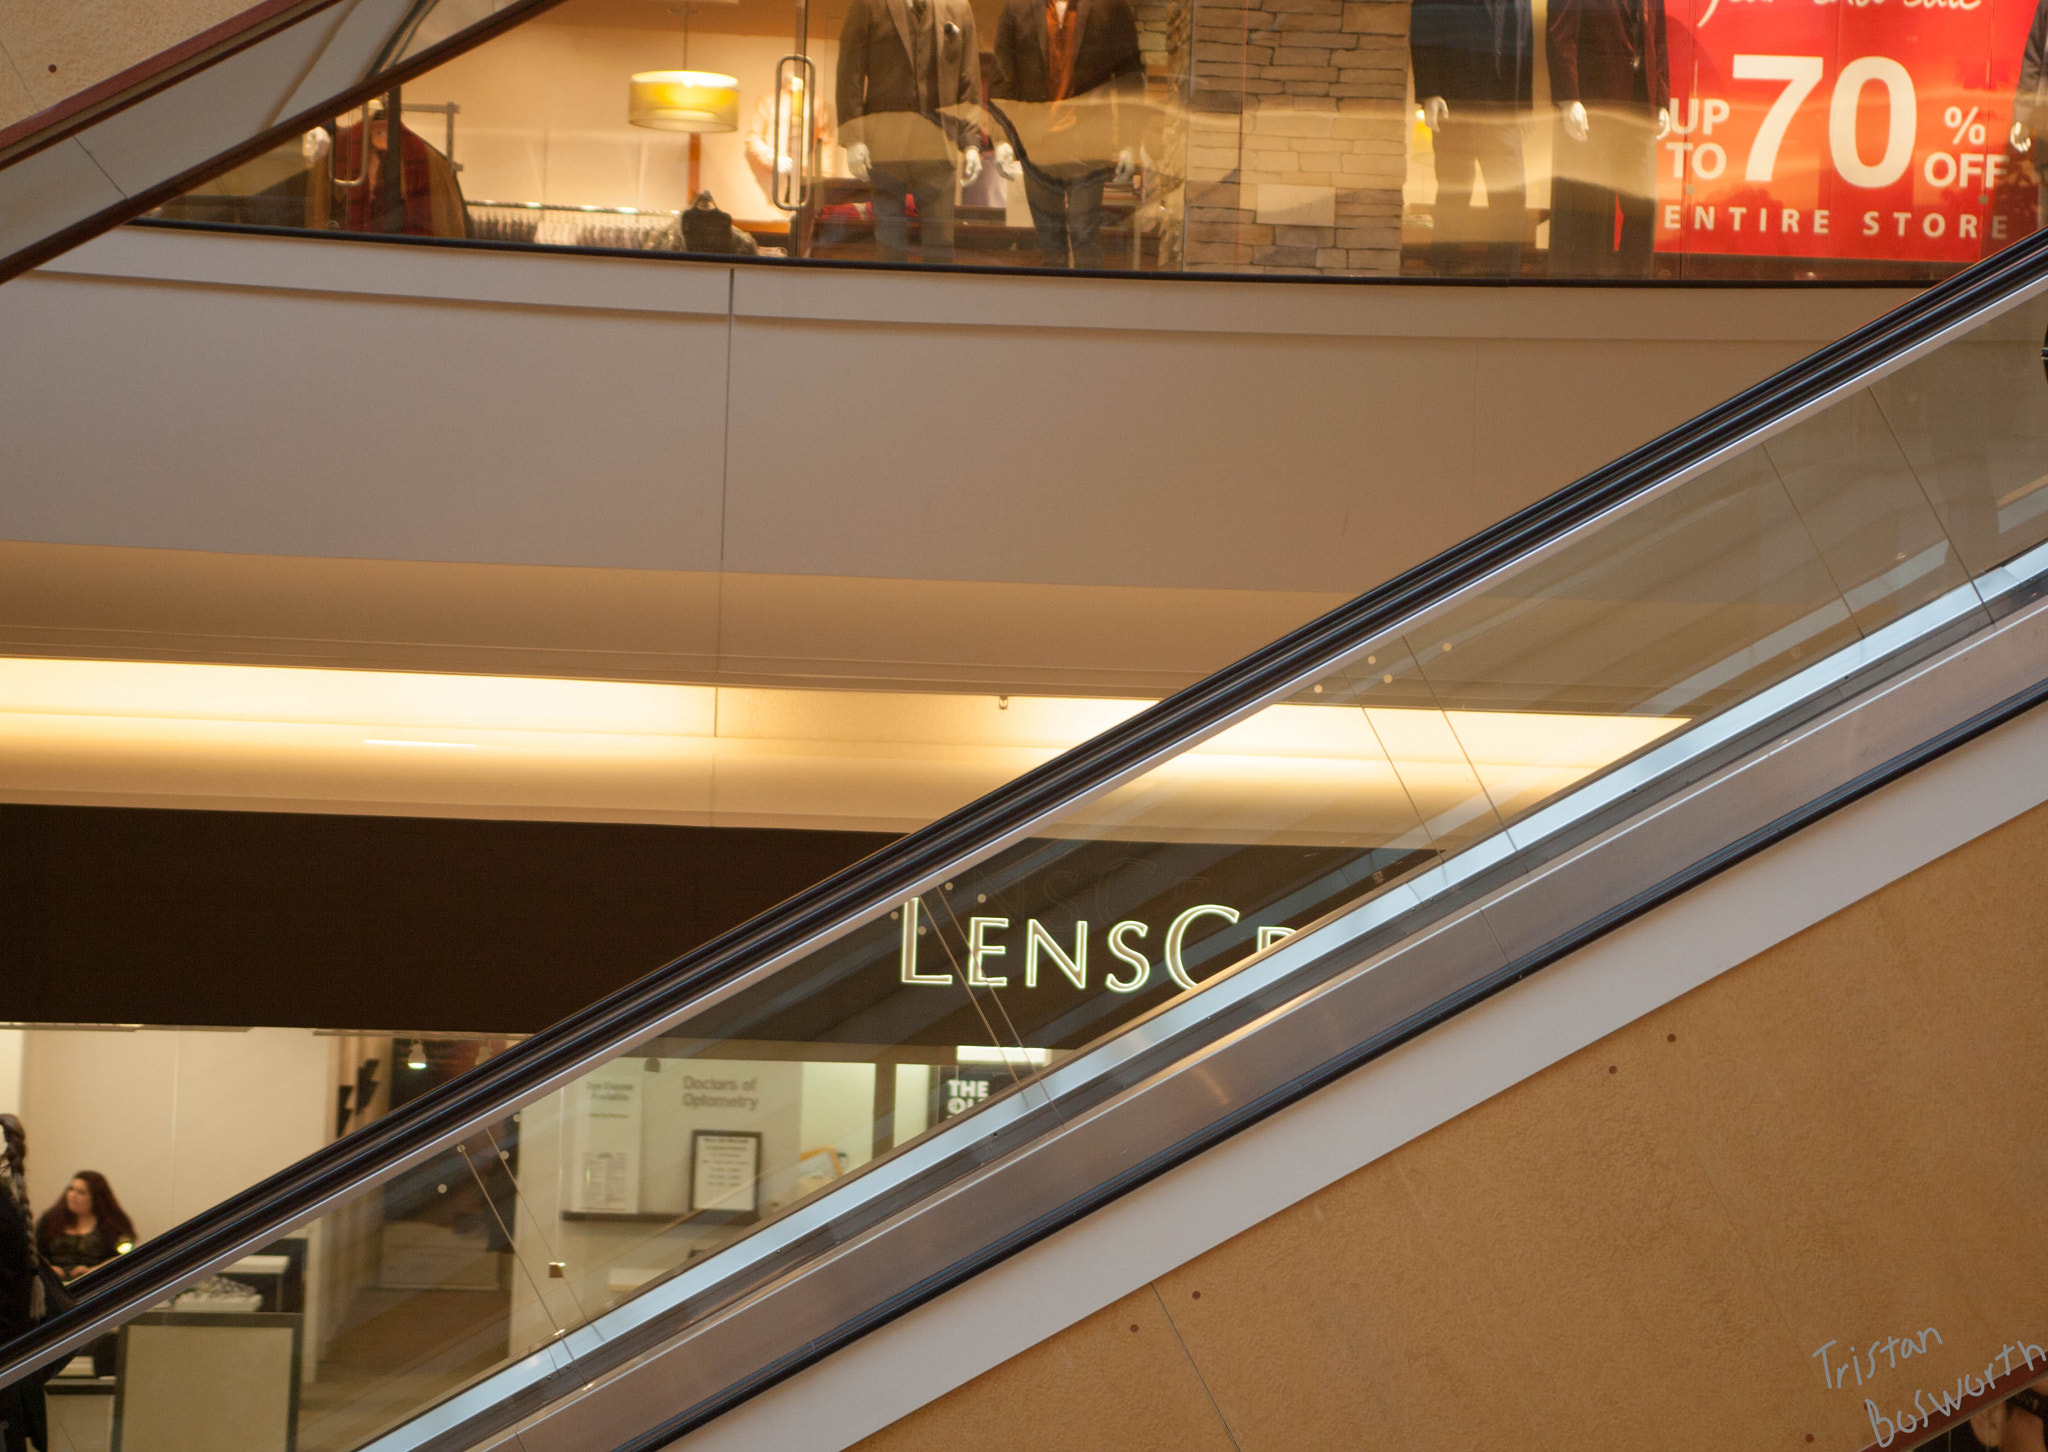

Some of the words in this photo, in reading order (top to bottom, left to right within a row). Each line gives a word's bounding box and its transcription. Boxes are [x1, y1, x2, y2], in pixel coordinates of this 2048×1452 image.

[1669, 98, 1730, 136] UP
[1732, 54, 1917, 189] 70
[1944, 106, 1986, 146] %
[1665, 142, 1727, 180] TO
[1923, 152, 2010, 189] OFF
[1664, 205, 1830, 234] ENTIRE
[1863, 211, 2008, 240] STORE
[683, 1075, 738, 1091] Doctors
[742, 1076, 757, 1091] of
[683, 1092, 758, 1111] Optometry
[947, 1079, 989, 1098] THE
